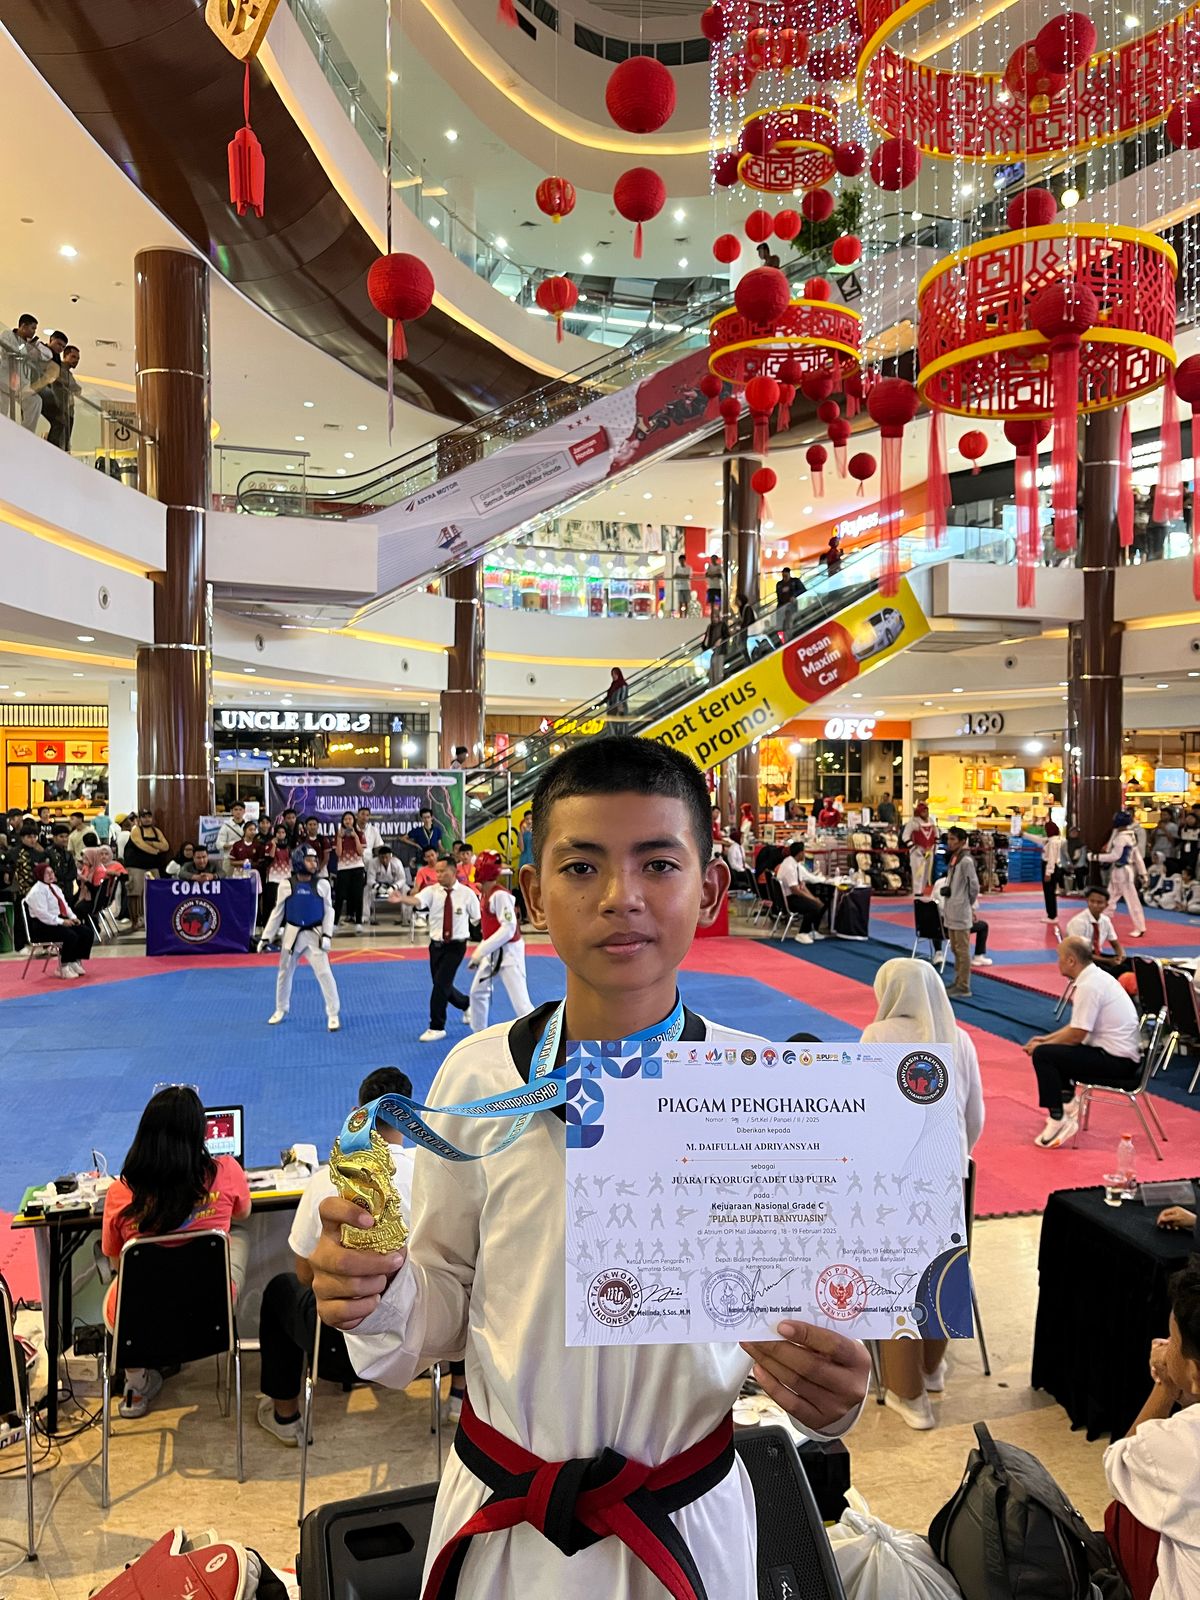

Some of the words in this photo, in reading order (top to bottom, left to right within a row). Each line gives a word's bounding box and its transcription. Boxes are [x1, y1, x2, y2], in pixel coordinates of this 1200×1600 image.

[417, 493, 436, 505] ASTRA
[436, 481, 459, 495] MOTOR
[483, 494, 504, 508] Semua
[504, 483, 526, 498] Sepeda
[526, 475, 542, 487] Motor
[543, 465, 562, 480] Honda
[796, 635, 833, 662] Pesan
[801, 649, 842, 678] Maxim
[818, 667, 840, 686] Car
[220, 710, 300, 730] UNCLE
[655, 714, 698, 746] mat
[697, 681, 757, 724] terus
[695, 697, 775, 764] promo!
[824, 716, 876, 740] OFC
[171, 880, 221, 895] COACH
[901, 1056, 919, 1088] BANYUASIN
[920, 1055, 944, 1088] TAEKWONDO
[485, 1081, 559, 1112] CHAMPIONSHIP
[906, 1089, 940, 1100] CHAMPIONSHIP
[380, 1101, 411, 1124] 2025
[658, 1097, 727, 1113] PIAGAM
[731, 1097, 866, 1113] PENGHARGAAN
[773, 1116, 792, 1124] Panpel
[767, 1127, 791, 1135] kepada
[686, 1143, 697, 1151] M.
[699, 1142, 751, 1151] DAIFULLAH
[754, 1142, 820, 1150] ADRIYANSYAH
[672, 1176, 701, 1185] JUARA
[709, 1176, 753, 1184] KYORUGI
[755, 1175, 787, 1184] CADET
[788, 1175, 804, 1184] U33
[806, 1175, 837, 1184] PUTRA
[711, 1202, 752, 1211] Kejuaraan
[754, 1202, 790, 1210] Nasional
[791, 1202, 816, 1210] Grade
[818, 1202, 824, 1210] C
[740, 1214, 772, 1223] BUPATI
[788, 1255, 812, 1263] Olahraga
[591, 1271, 640, 1299] TAEKWONDO
[820, 1267, 862, 1284] BUPATI
